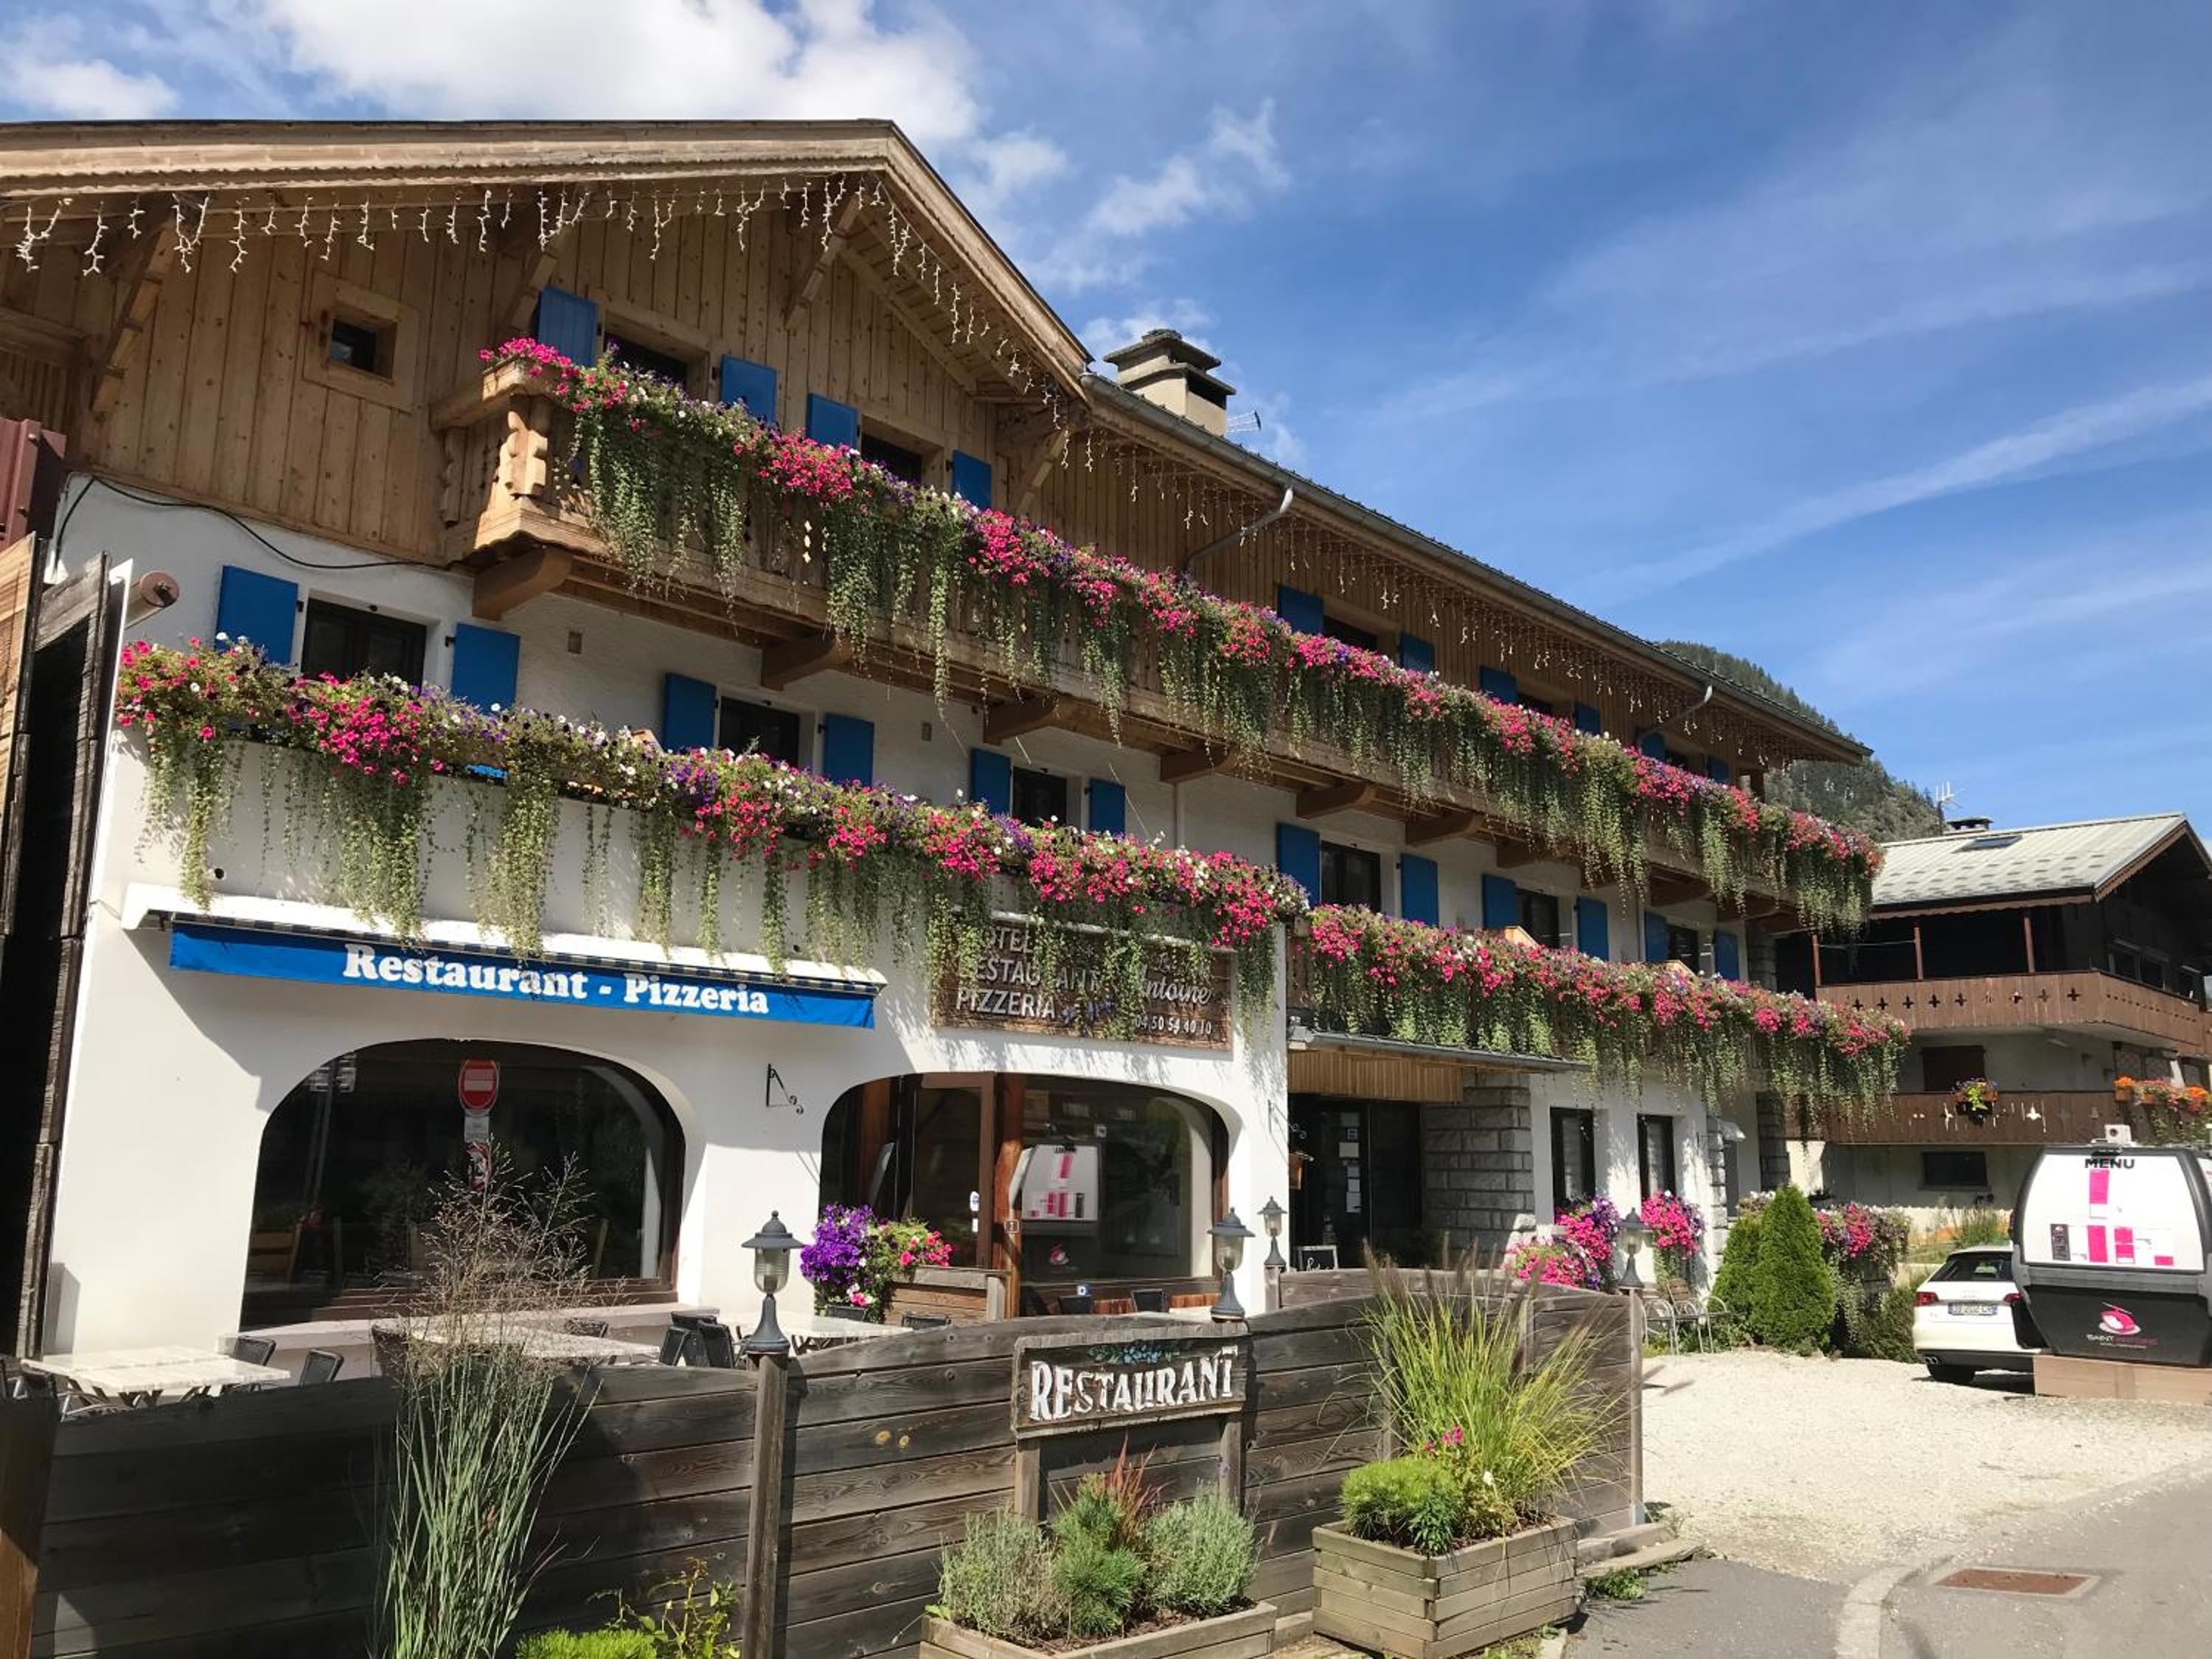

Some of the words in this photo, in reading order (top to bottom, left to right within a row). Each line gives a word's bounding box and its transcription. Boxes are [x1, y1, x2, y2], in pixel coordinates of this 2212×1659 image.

[342, 943, 588, 999] Restaurant
[623, 973, 769, 1014] Pizzeria
[956, 987, 1055, 1018] PIZZERIA
[1151, 1015, 1164, 1030] 50
[2084, 1158, 2135, 1169] MENU
[1029, 1344, 1239, 1422] RESTAURANT
